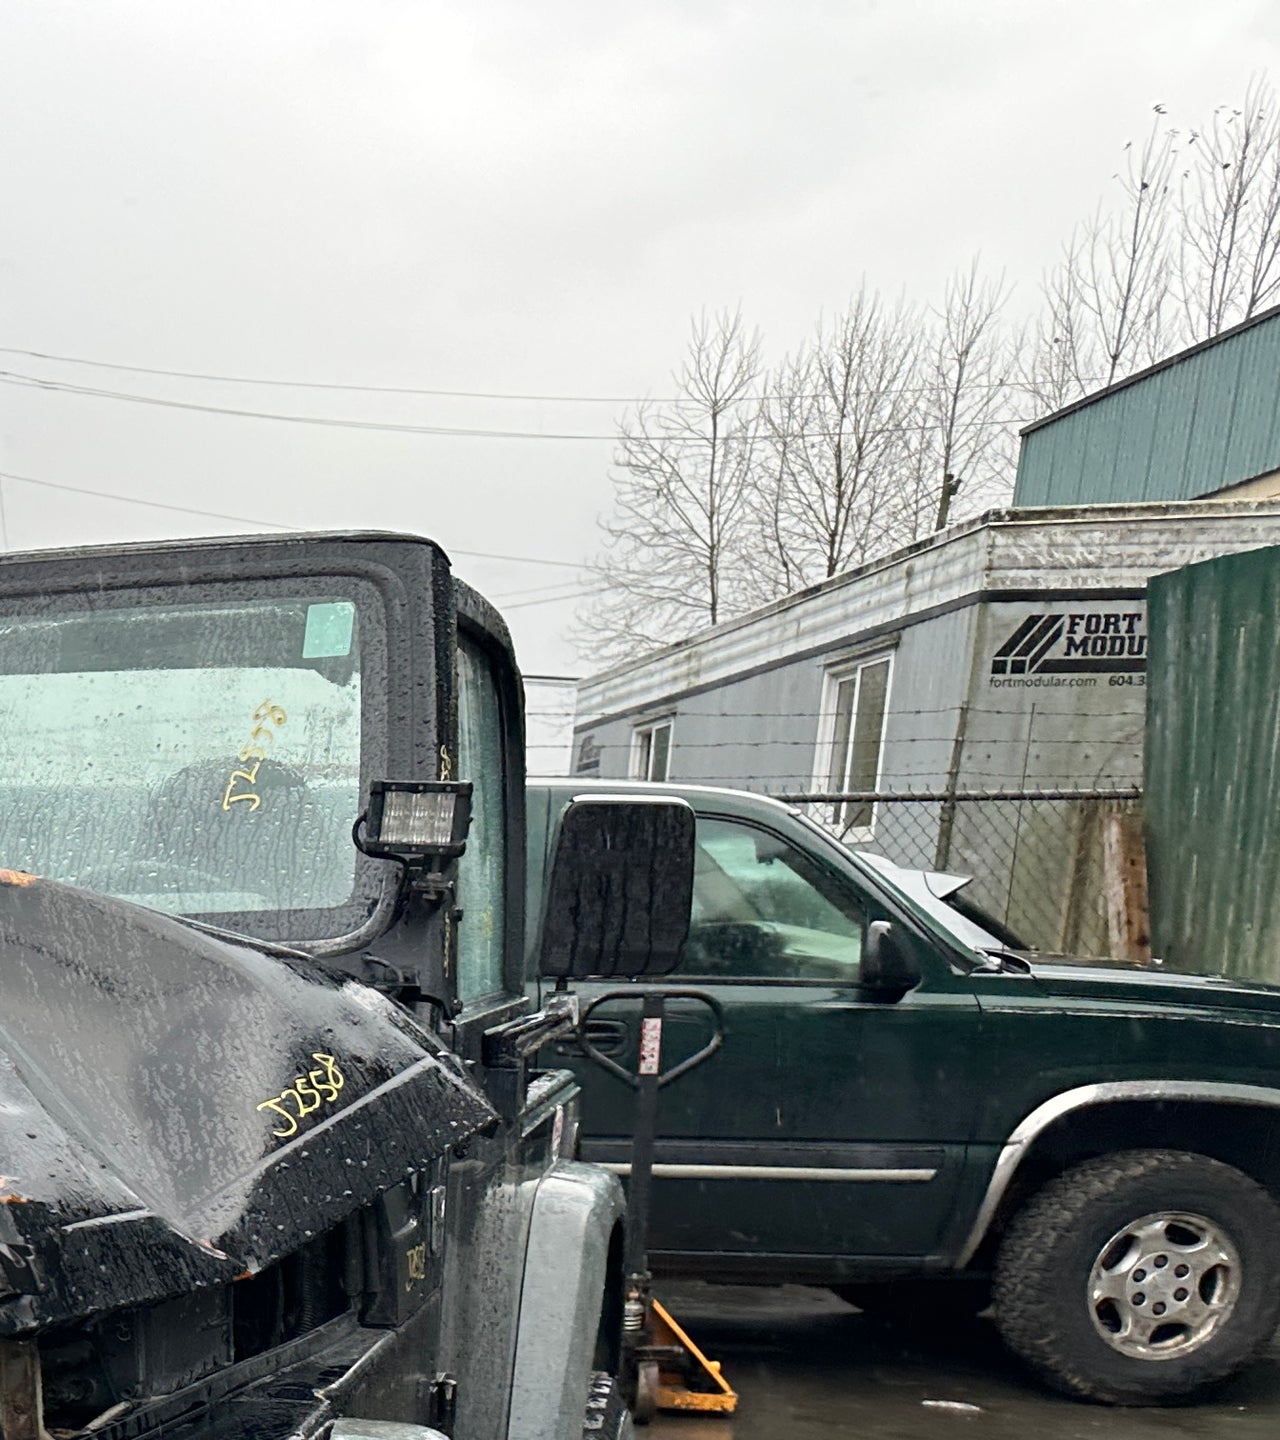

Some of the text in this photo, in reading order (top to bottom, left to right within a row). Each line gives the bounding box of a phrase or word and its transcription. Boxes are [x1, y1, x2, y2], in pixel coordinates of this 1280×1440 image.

[1065, 613, 1142, 635] FORT
[990, 676, 1097, 688] fortmodular.com
[224, 699, 287, 811] J2558
[256, 1053, 344, 1137] J2558
